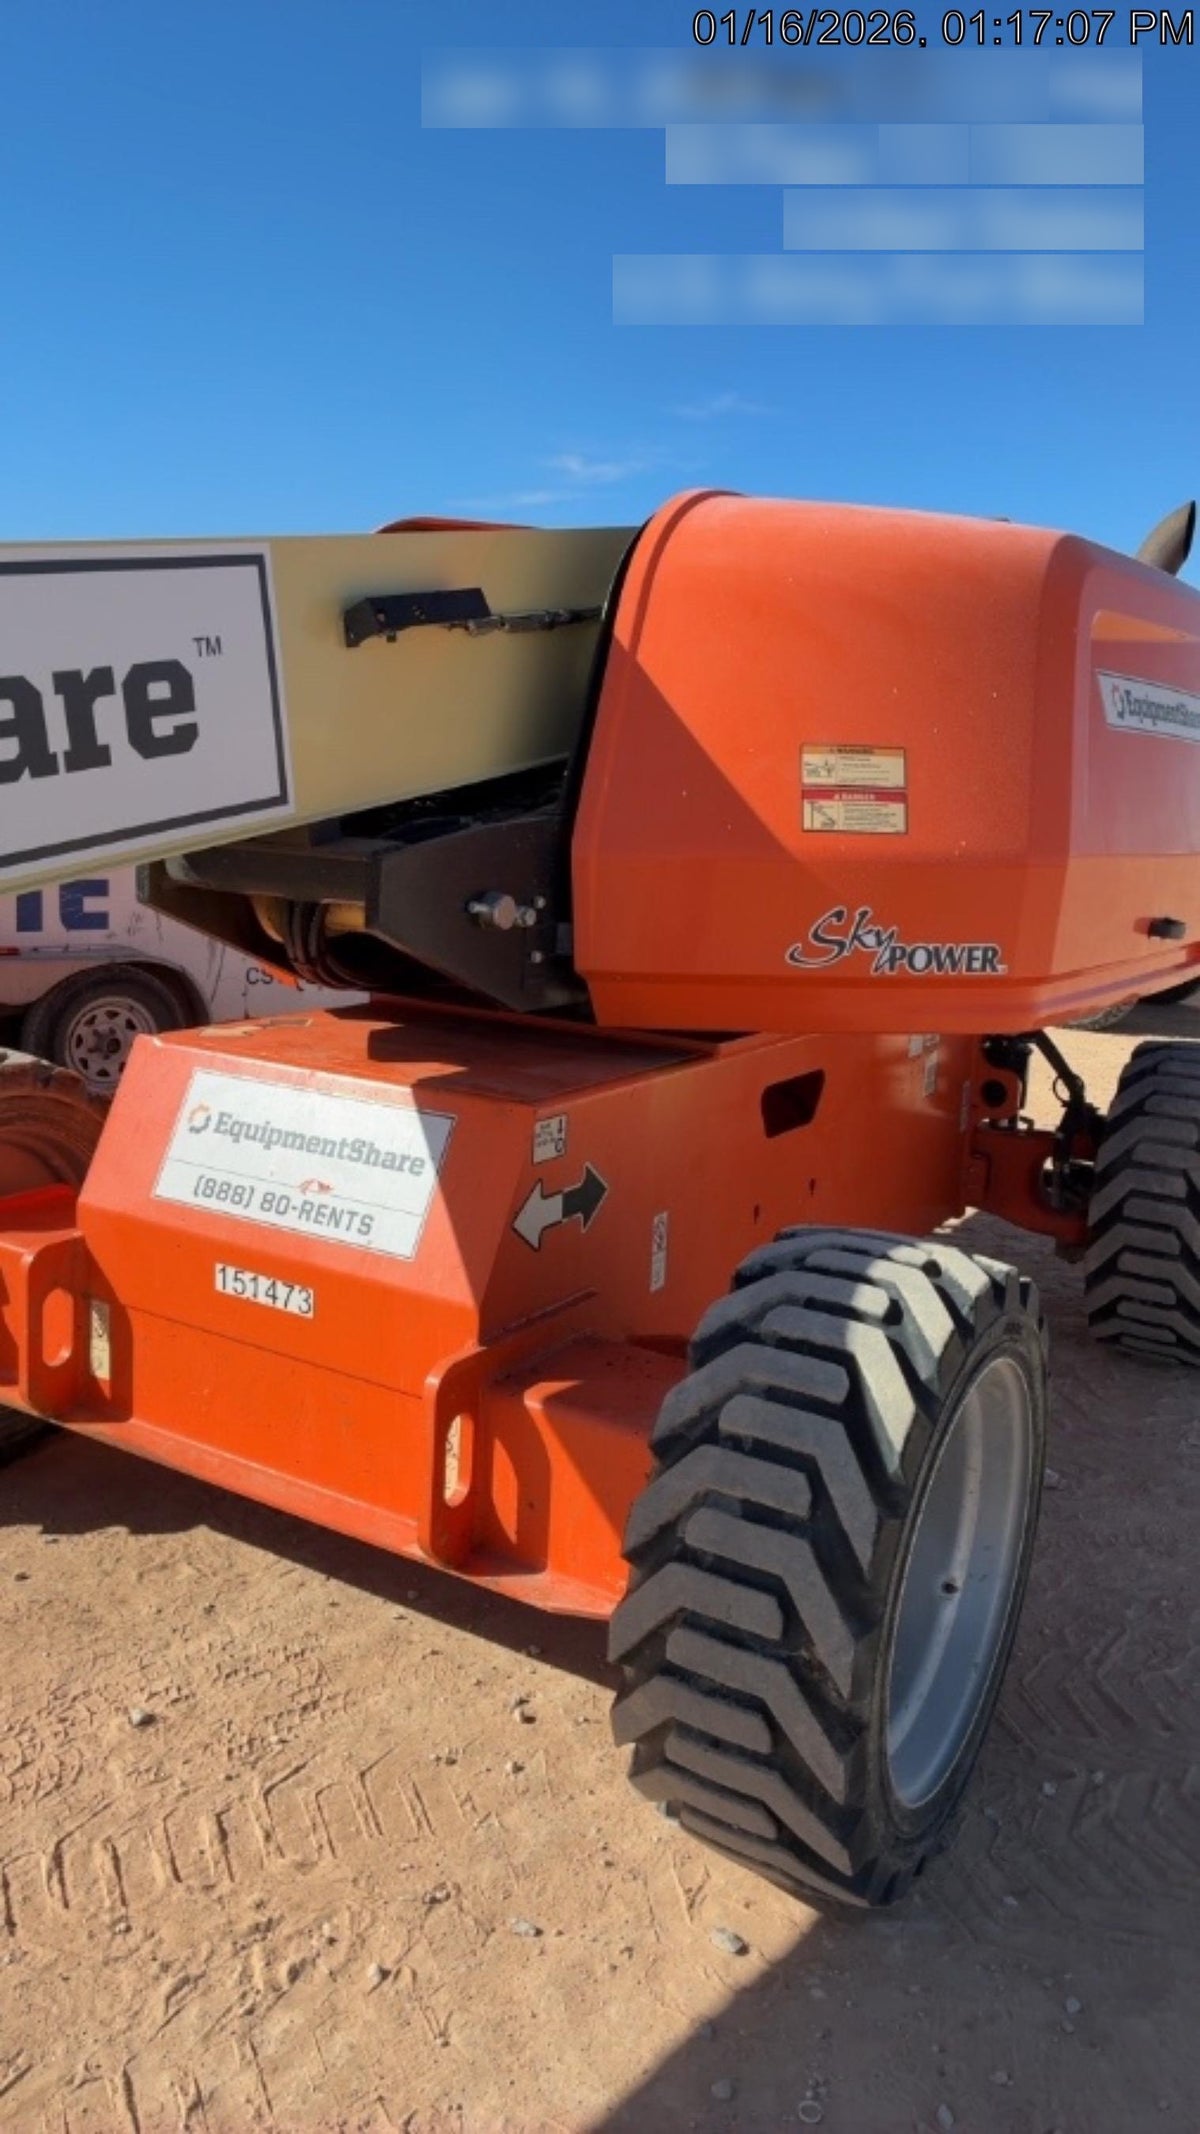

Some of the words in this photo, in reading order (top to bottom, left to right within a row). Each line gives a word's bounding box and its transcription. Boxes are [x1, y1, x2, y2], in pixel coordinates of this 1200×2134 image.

[213, 1110, 426, 1177] EquipmentShare
[193, 1174, 255, 1209] (888)
[260, 1191, 375, 1236] 80-RENTS
[217, 1265, 313, 1315] 151473
